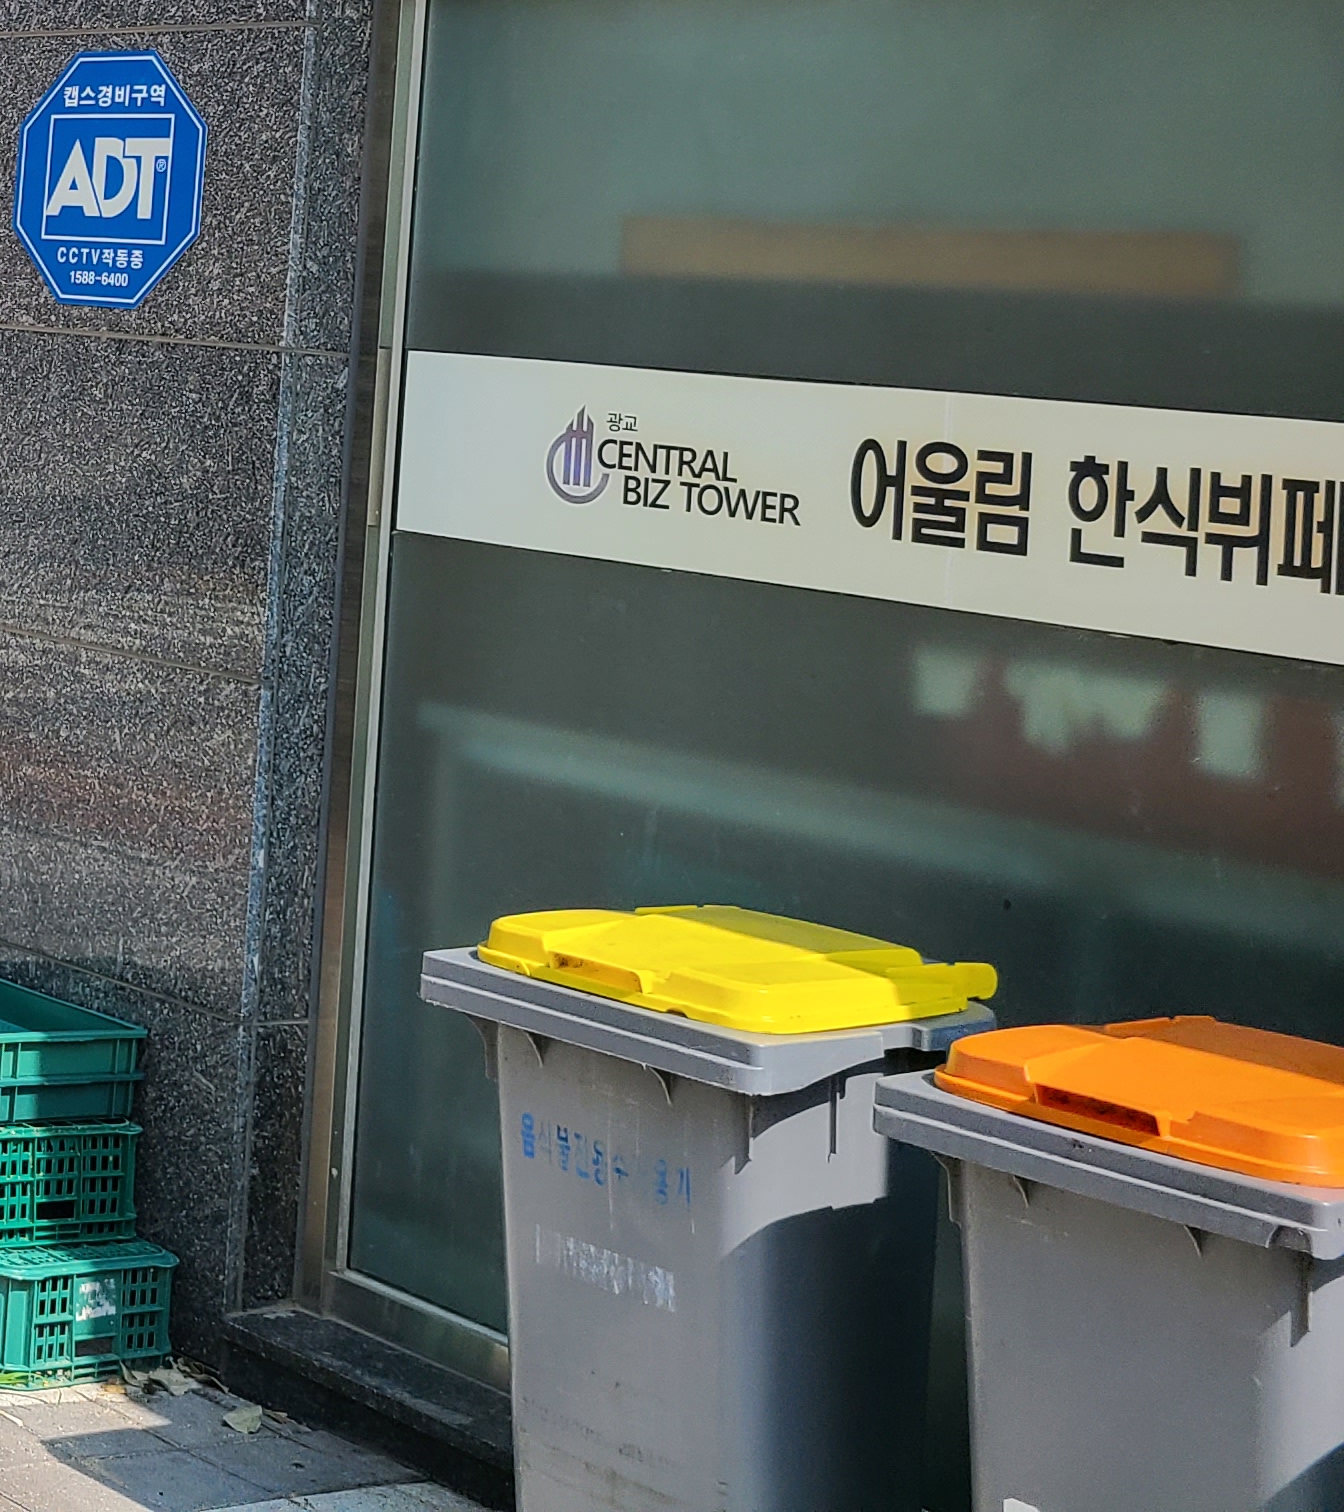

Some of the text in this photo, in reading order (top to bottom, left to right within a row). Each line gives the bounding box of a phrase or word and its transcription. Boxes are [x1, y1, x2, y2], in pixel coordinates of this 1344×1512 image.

[63, 84, 166, 108] 캡스경비구역
[46, 137, 171, 220] ADT
[57, 247, 144, 270] CCTV작동중
[69, 270, 129, 287] 1588-6400
[606, 412, 639, 432] 광교
[597, 438, 738, 484] CENTRAL
[622, 474, 801, 527] BIZ TOWER
[850, 438, 1344, 596] 어울림 한식뷔페
